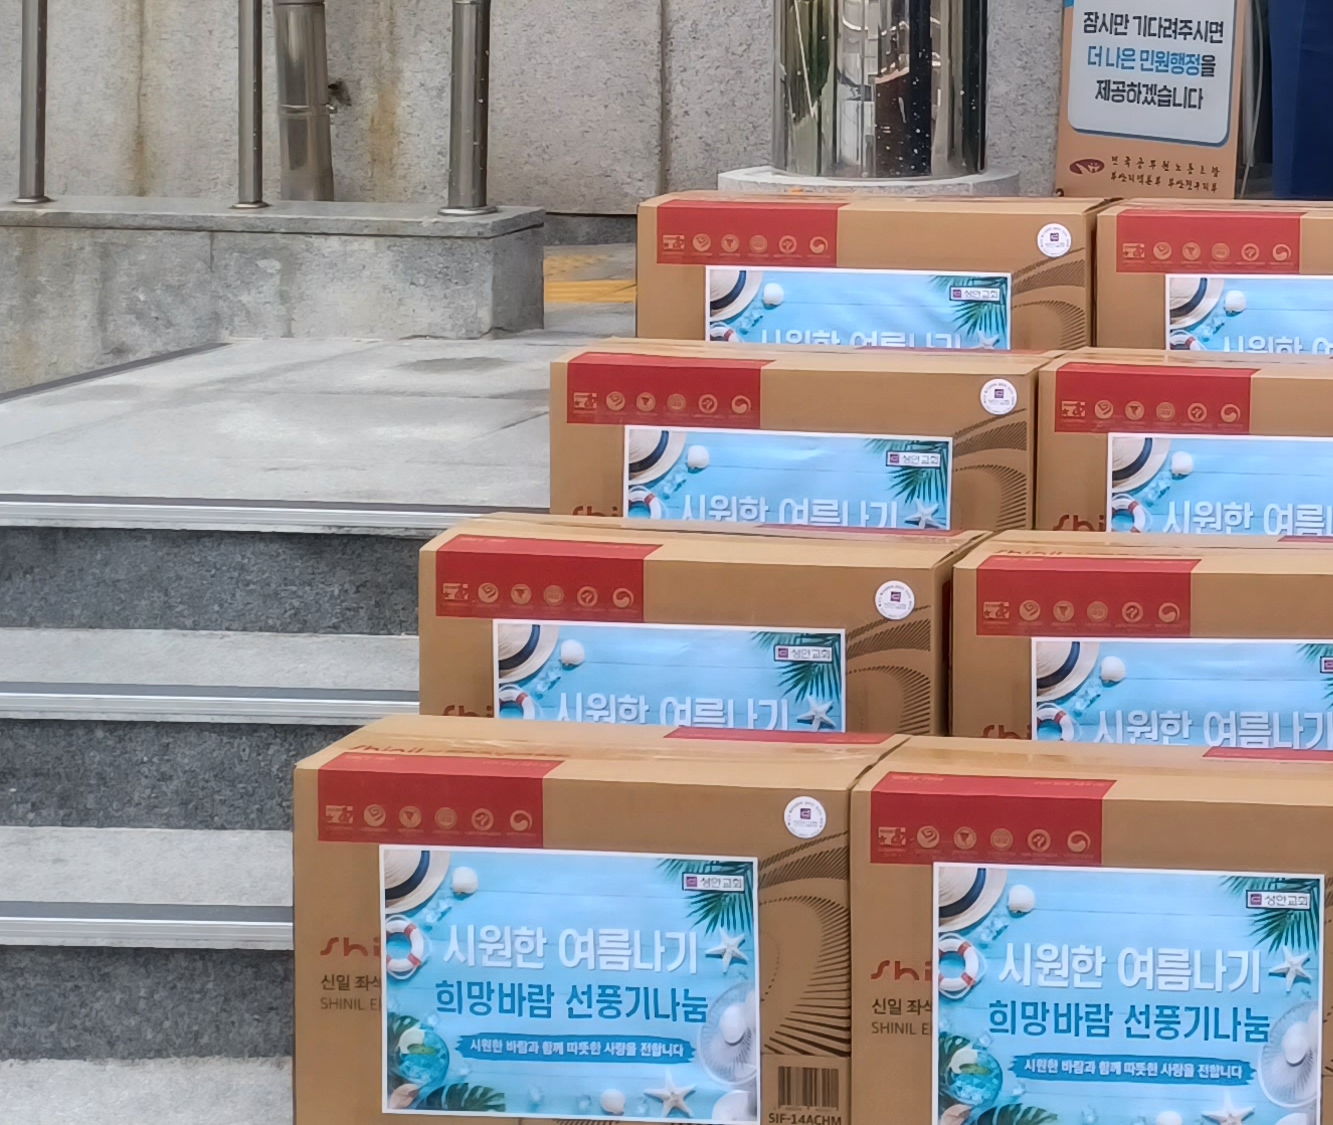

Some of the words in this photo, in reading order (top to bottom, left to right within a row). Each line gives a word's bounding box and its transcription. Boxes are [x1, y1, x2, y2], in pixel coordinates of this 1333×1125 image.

[1083, 11, 1130, 36] 잠시만
[1133, 15, 1224, 44] 기다려주시면
[1087, 45, 1102, 67] 더
[1106, 46, 1136, 70] 나은
[1139, 49, 1216, 78] 민원행정을
[1095, 79, 1204, 110] 제공하겠습니다
[700, 876, 744, 890] 성안교회
[1264, 894, 1309, 908] 성안교회
[442, 924, 548, 971] 시원한
[558, 927, 698, 974] 여름나기
[999, 942, 1107, 989] 시원한
[1117, 946, 1261, 993] 여름나기
[321, 974, 350, 991] 신일
[320, 996, 365, 1011] SHINIL
[435, 980, 555, 1019] 희망바람
[566, 984, 709, 1024] 선풍기나눔
[871, 997, 902, 1015] 신일
[871, 1021, 917, 1035] SHINIL
[989, 1000, 1114, 1038] 희망바람
[1124, 1004, 1270, 1043] 선풍기나눔
[470, 1039, 503, 1054] 시원한
[1024, 1059, 1058, 1074] 시원한
